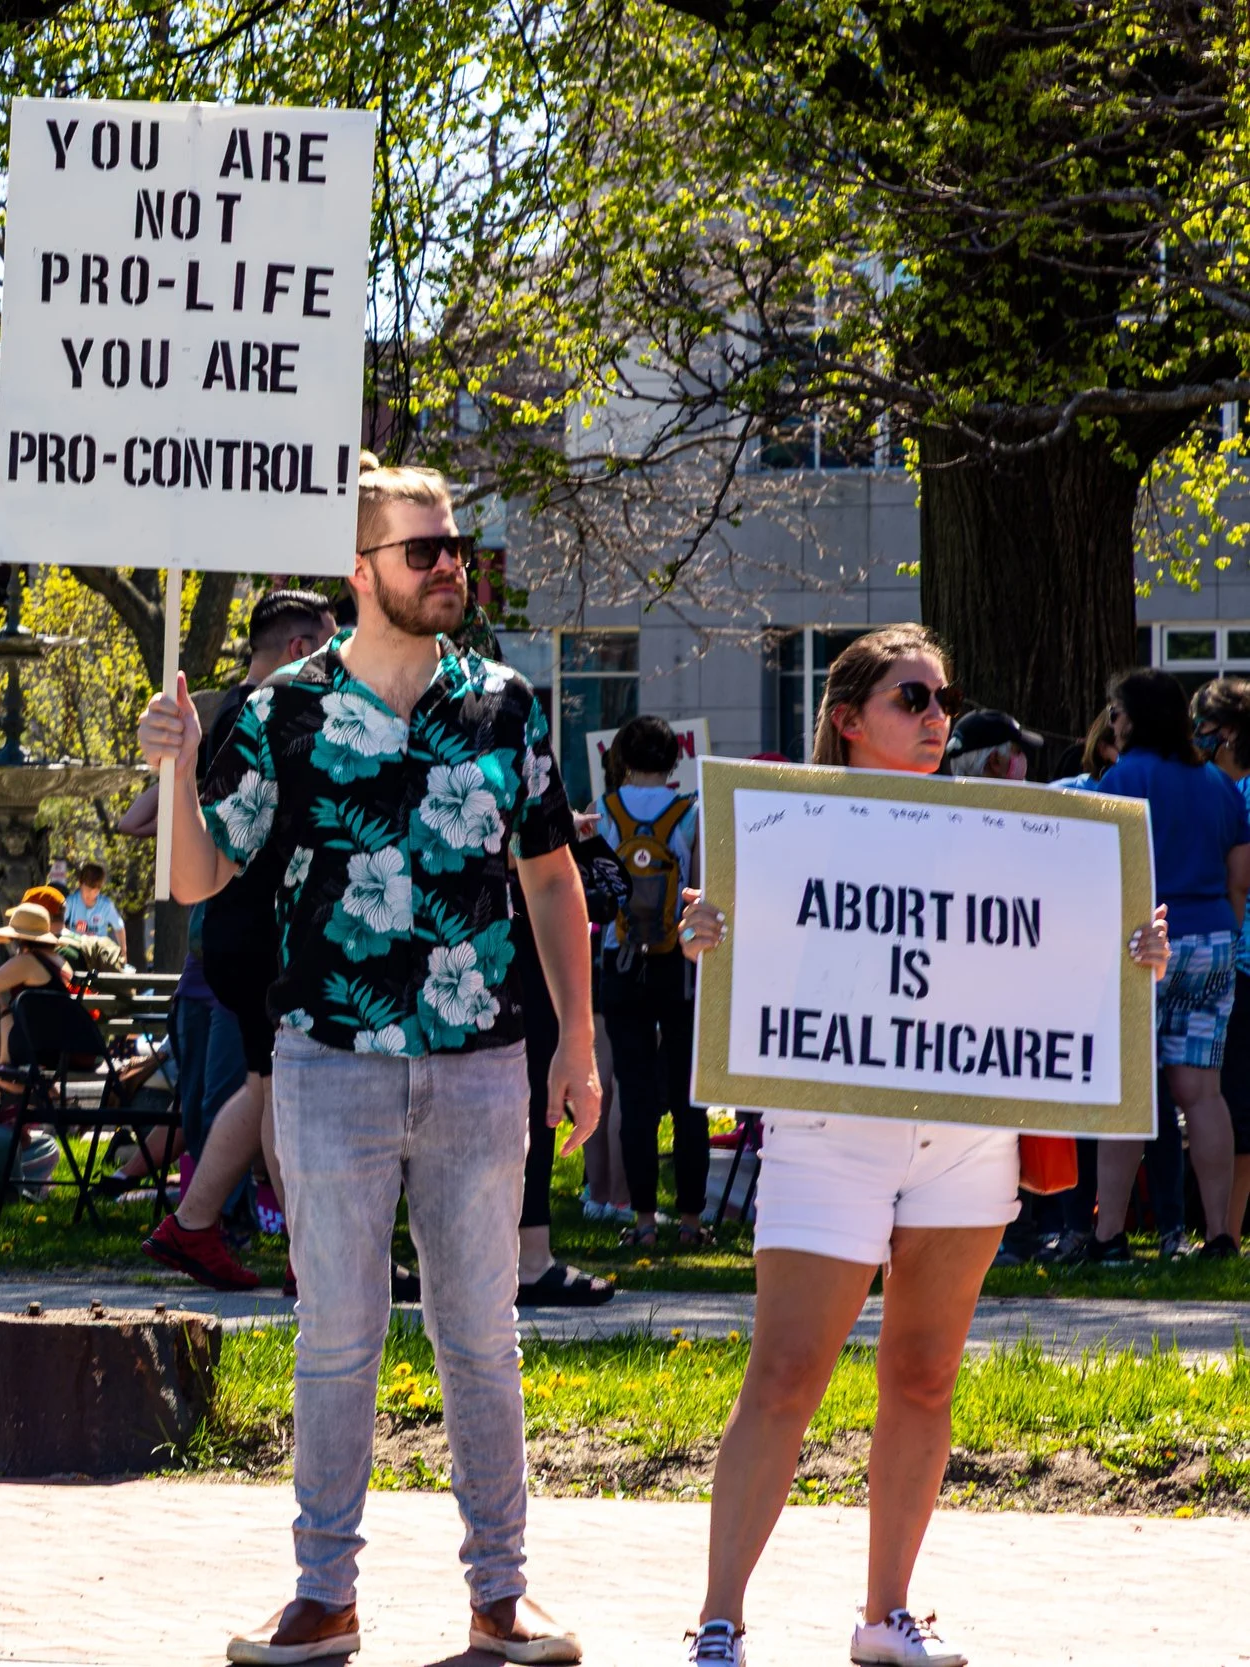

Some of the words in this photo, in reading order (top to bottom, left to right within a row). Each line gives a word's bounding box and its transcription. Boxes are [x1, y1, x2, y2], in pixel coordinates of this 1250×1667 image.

[46, 118, 161, 172] YOU
[218, 127, 329, 184] ARE
[134, 188, 242, 243] NOT
[41, 251, 335, 318] PRO-LIFE
[61, 337, 171, 391] YOU
[202, 339, 300, 395] ARE
[7, 430, 350, 497] PRO-CONTROL!
[795, 877, 1042, 949] ABORTION
[889, 944, 931, 1001] IS
[758, 1005, 1094, 1084] HEALTHCARE!
